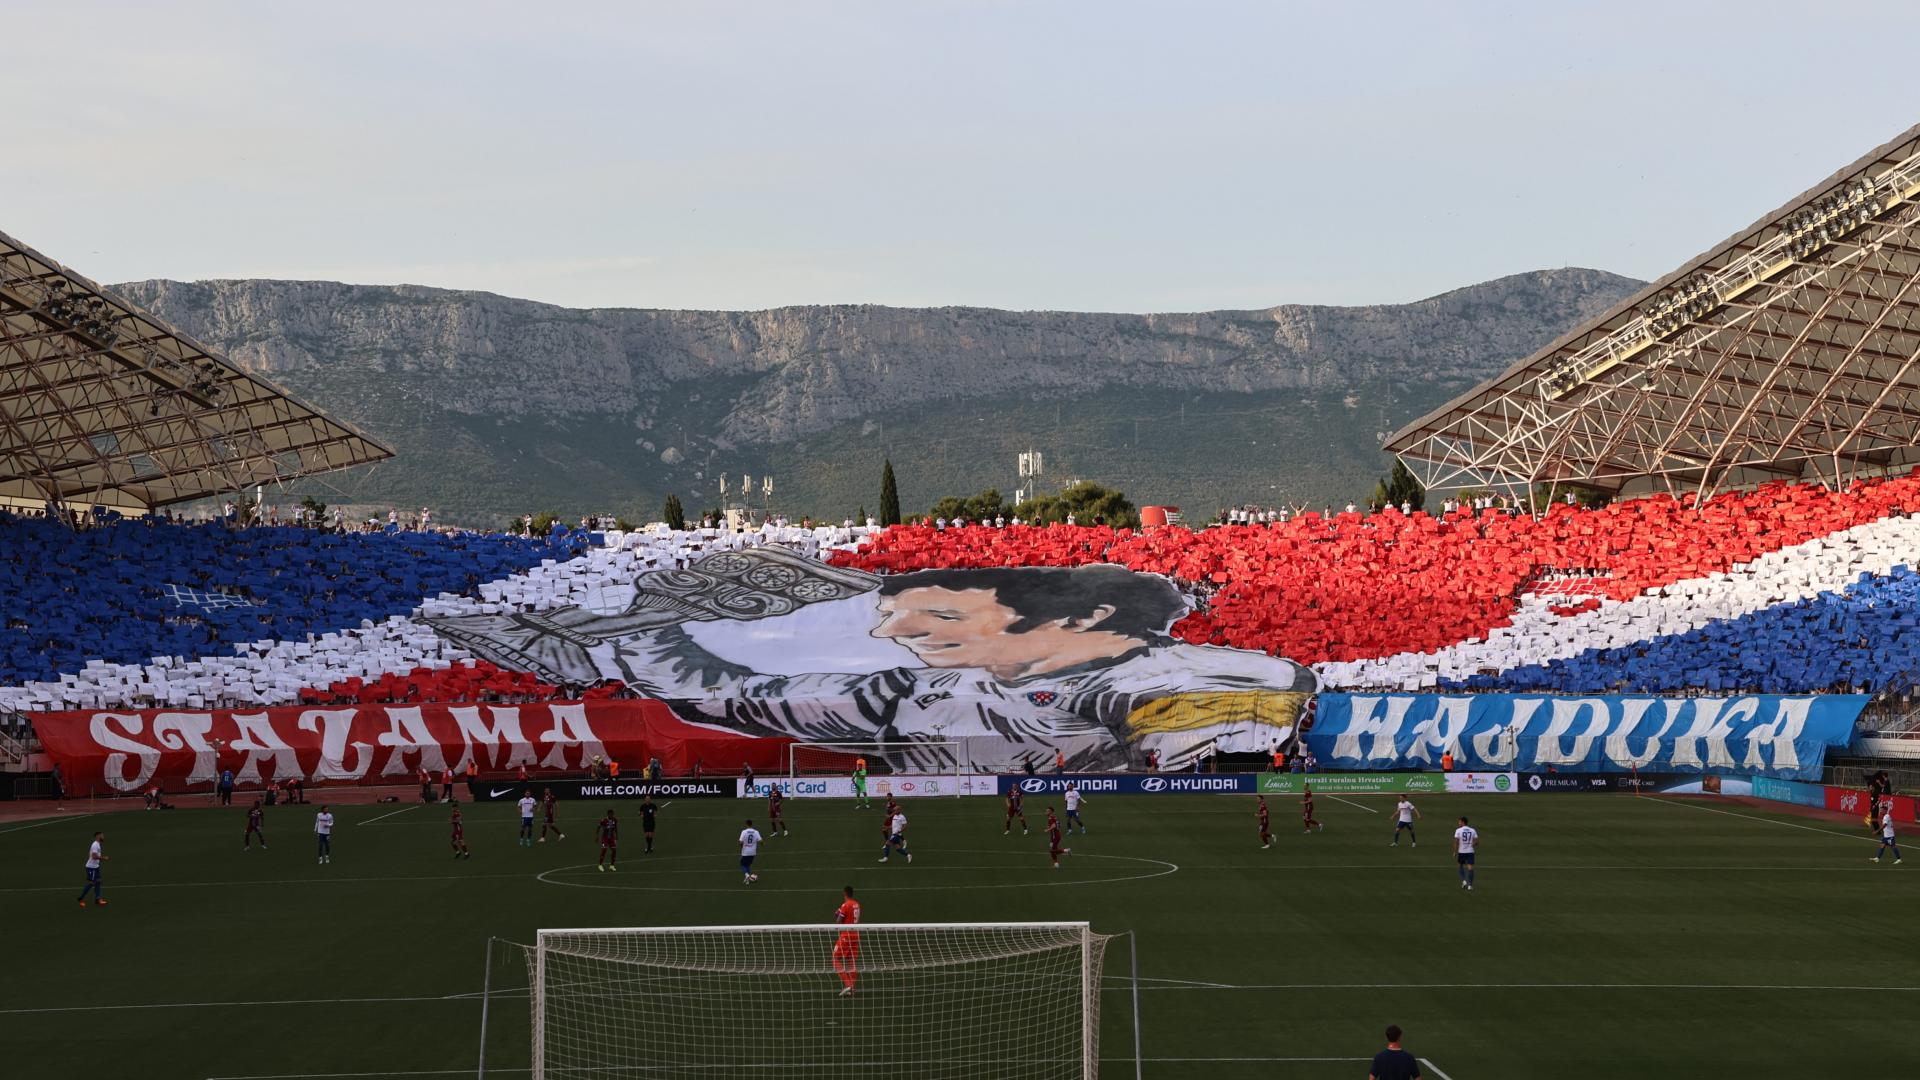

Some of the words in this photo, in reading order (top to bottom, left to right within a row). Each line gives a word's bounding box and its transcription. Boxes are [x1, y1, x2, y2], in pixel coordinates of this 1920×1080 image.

[1331, 696, 1818, 770] HAJDUKA
[89, 704, 613, 791] STAZAMA
[795, 781, 827, 793] Card
[1050, 779, 1118, 791] HYUNDAI
[1171, 779, 1238, 790] HYUNDAI
[1545, 779, 1578, 787] PREMIUM
[1591, 779, 1607, 787] VISA
[580, 783, 721, 797] NIKE.COM/FOOTBALL
[1462, 831, 1472, 843] 97
